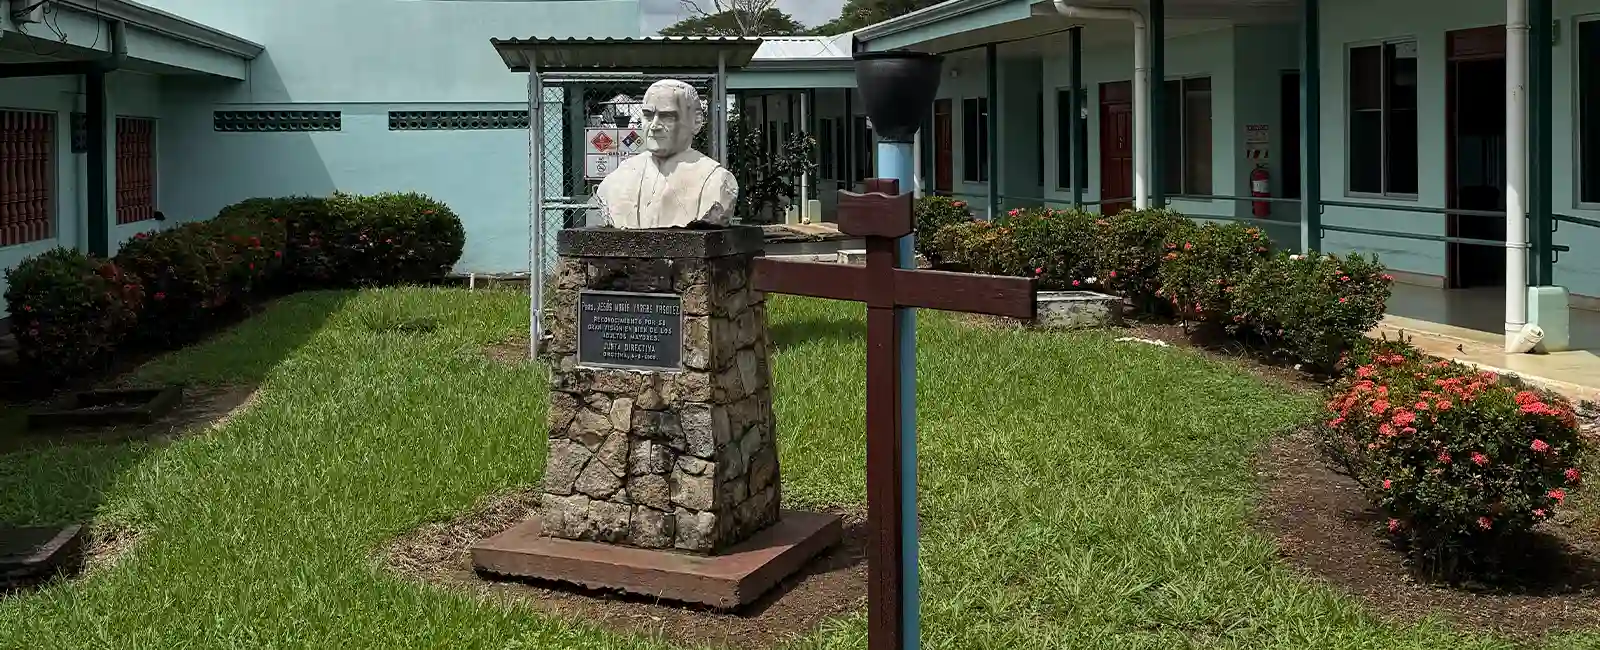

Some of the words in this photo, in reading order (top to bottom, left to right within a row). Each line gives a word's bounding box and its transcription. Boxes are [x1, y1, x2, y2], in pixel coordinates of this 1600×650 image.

[594, 316, 642, 324] RECONOCIMIENTO
[603, 342, 620, 350] JUNTA
[624, 343, 656, 352] DIRECTIVA
